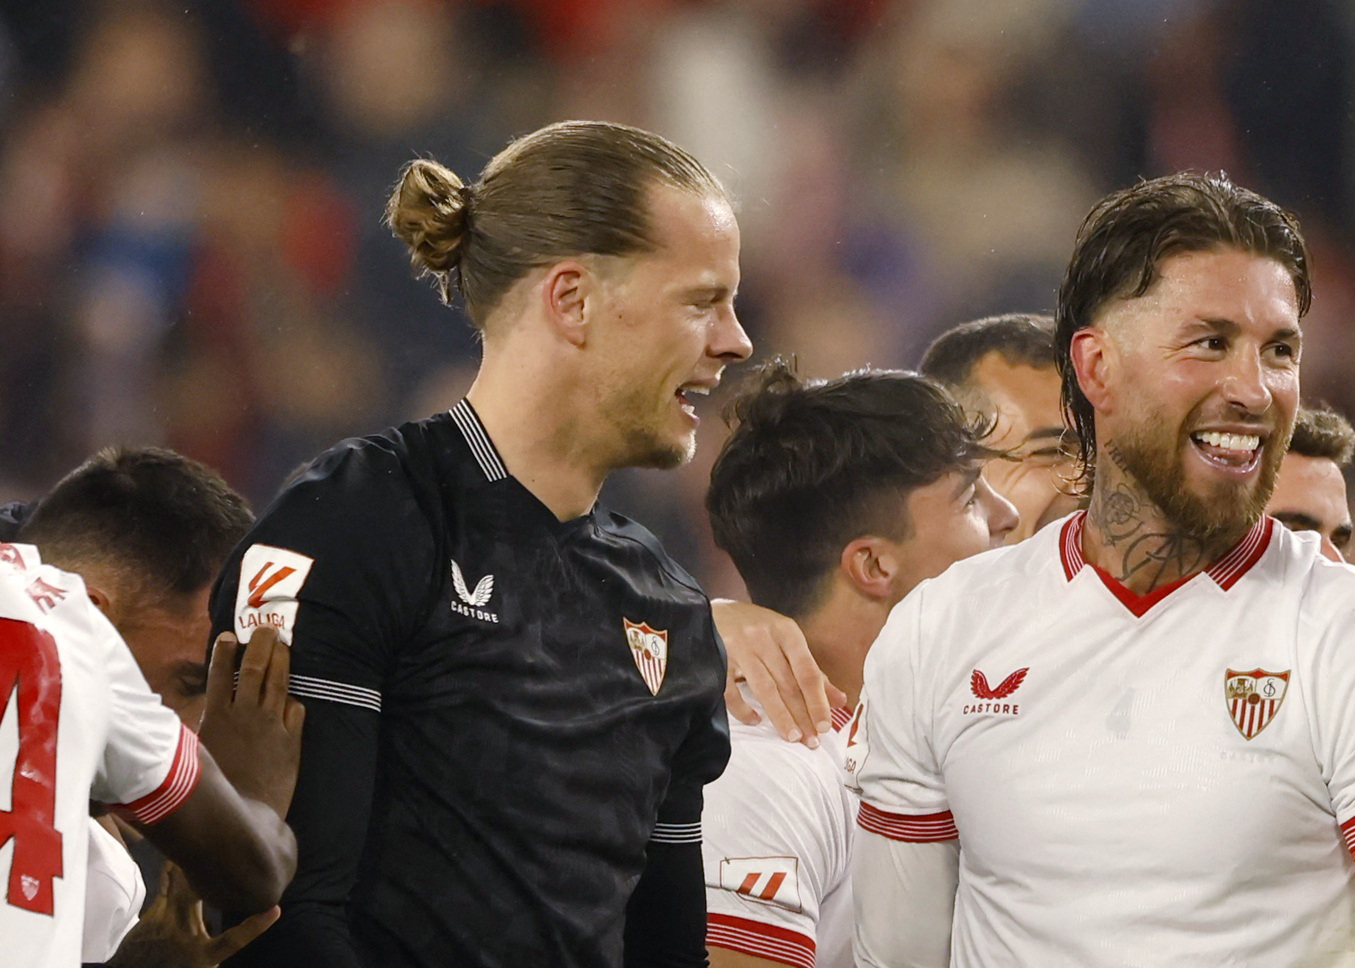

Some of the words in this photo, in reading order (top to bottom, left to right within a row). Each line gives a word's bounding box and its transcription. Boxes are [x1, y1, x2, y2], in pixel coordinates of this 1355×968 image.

[238, 612, 286, 630] LALIGA
[450, 600, 499, 624] CASTORE
[962, 702, 1020, 716] CASTORE
